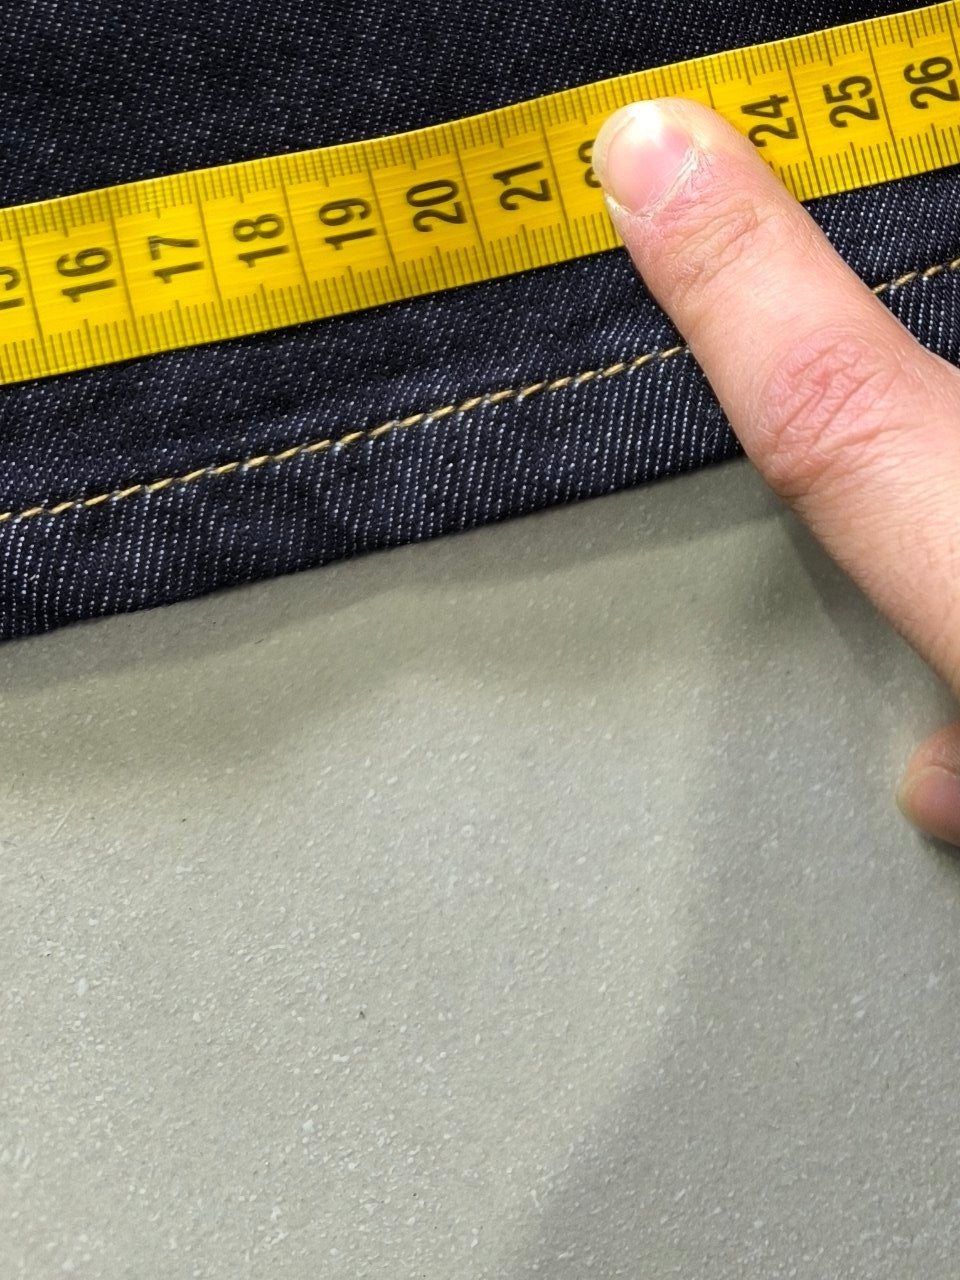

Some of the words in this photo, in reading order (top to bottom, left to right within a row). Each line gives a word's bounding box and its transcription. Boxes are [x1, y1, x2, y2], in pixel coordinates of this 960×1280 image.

[823, 75, 880, 128] 25
[903, 55, 960, 111] 26
[742, 93, 797, 148] 24
[406, 178, 466, 233] 20
[492, 160, 552, 211] 21
[233, 213, 290, 268] 18
[318, 197, 377, 251] 19
[56, 246, 118, 302] 16
[149, 235, 204, 284] 17
